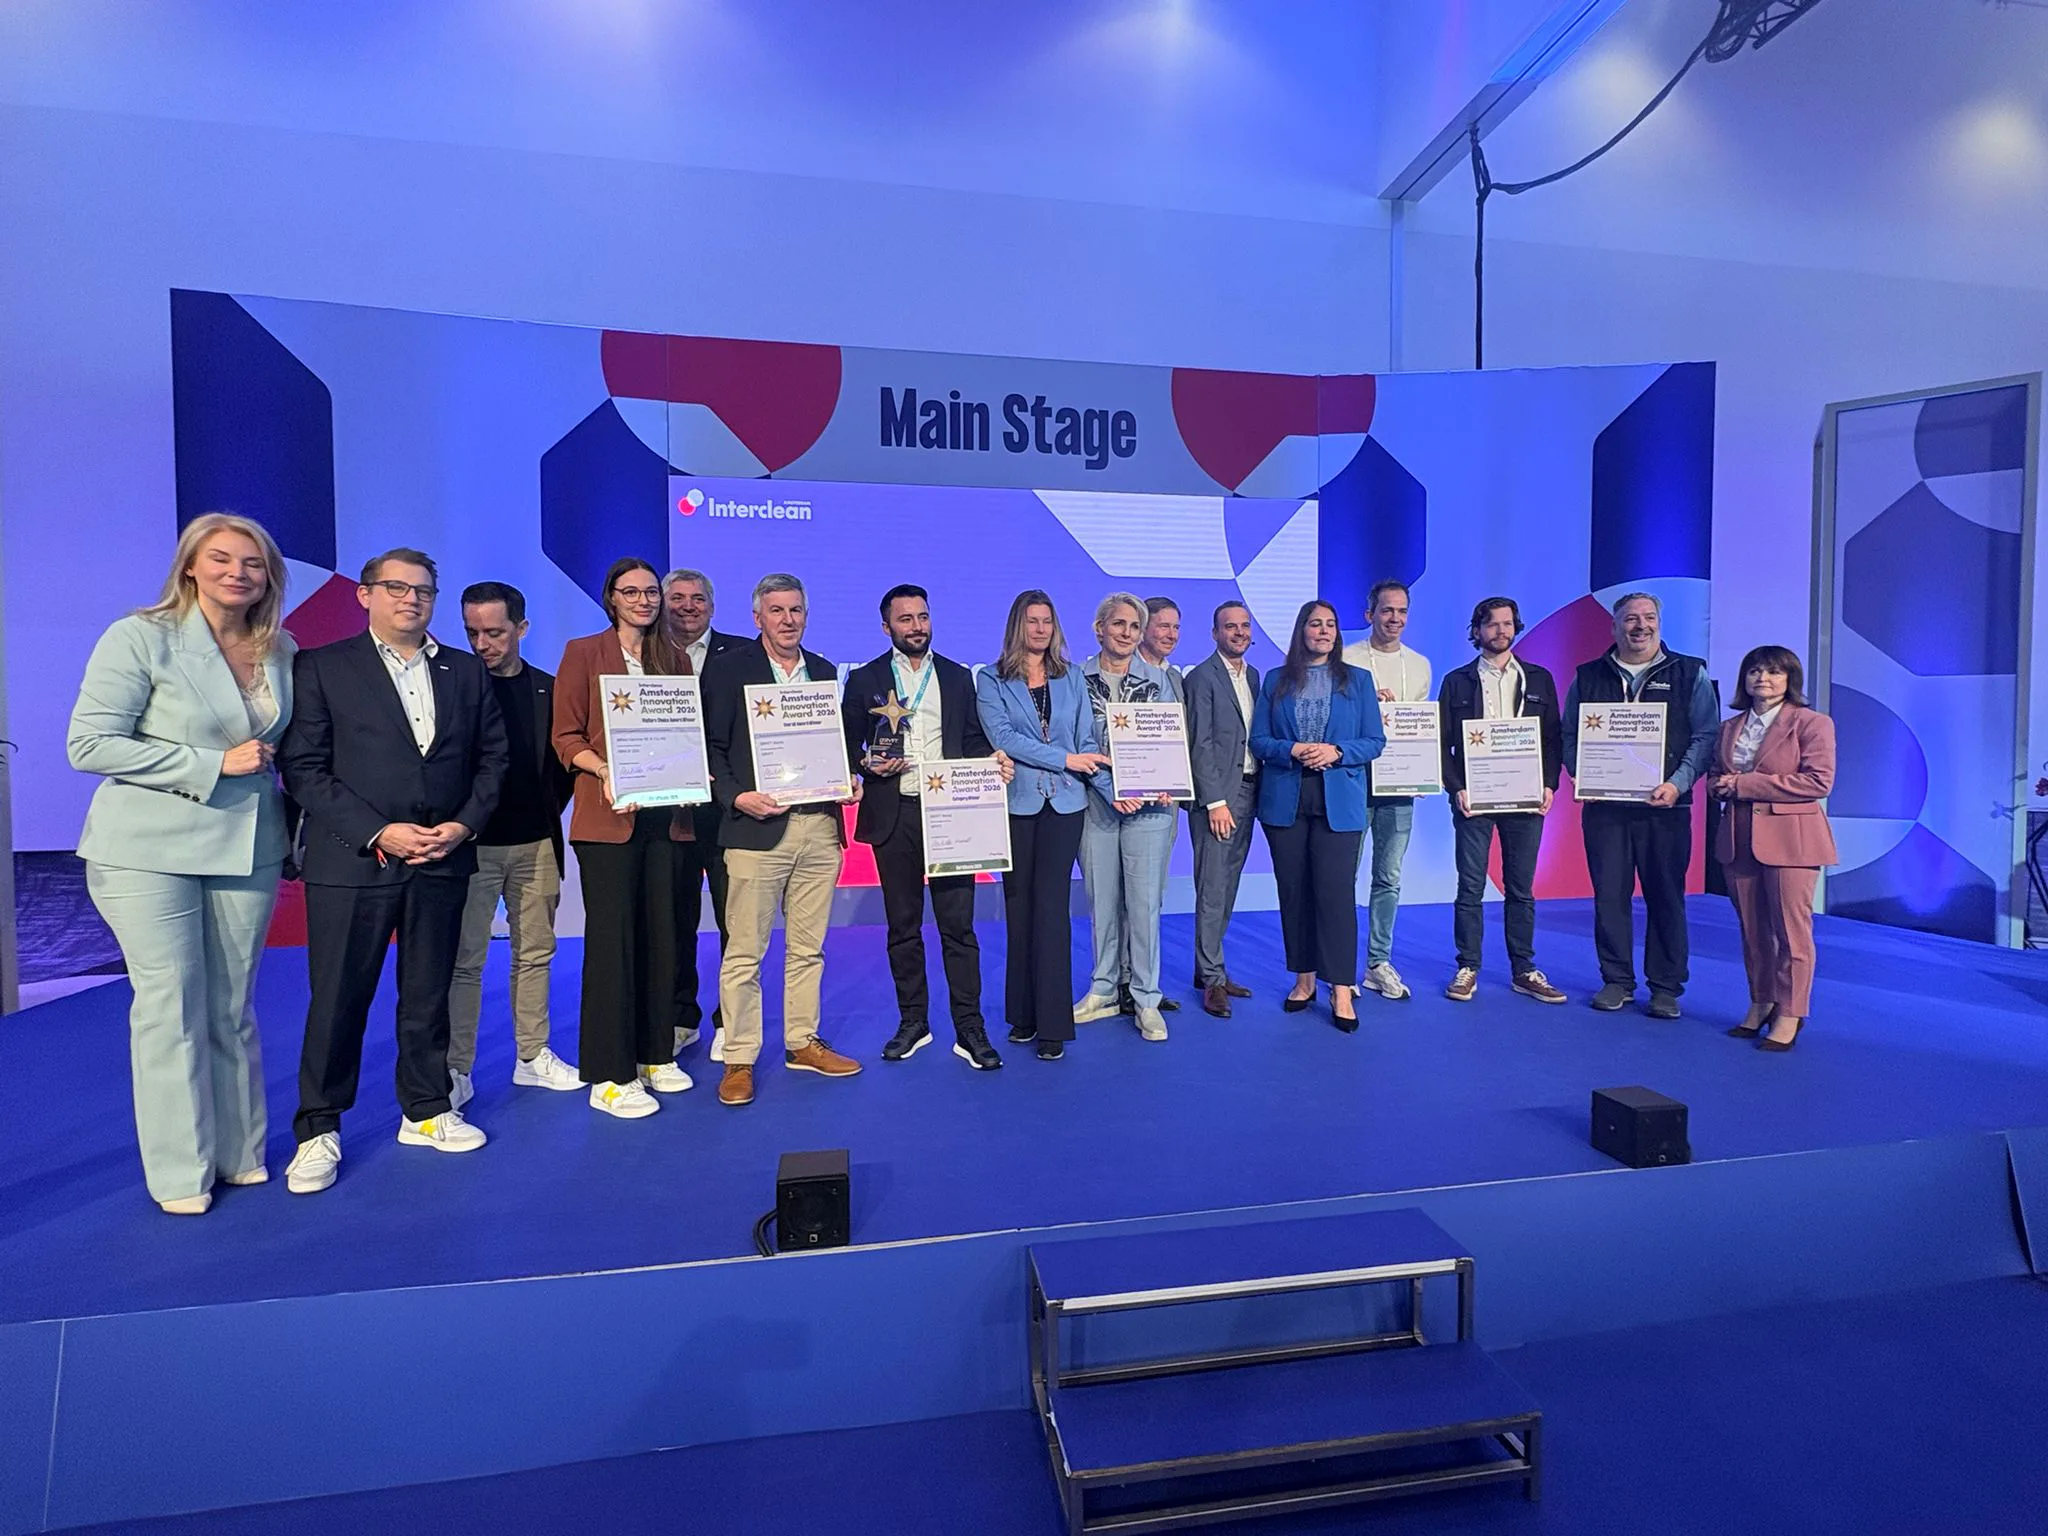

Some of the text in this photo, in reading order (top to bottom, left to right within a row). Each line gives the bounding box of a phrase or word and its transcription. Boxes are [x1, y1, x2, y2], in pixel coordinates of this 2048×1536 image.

[880, 386, 1137, 470] Main Stage
[708, 497, 812, 520] Interclean
[639, 688, 695, 696] Amsterdam
[640, 697, 690, 705] Innovation
[780, 692, 834, 702] Amsterdam
[641, 706, 696, 714] Award 2026
[781, 702, 830, 711] Innovation
[782, 709, 836, 719] Award 2026
[951, 768, 1001, 778] Amsterdam
[951, 777, 996, 786] Innovation
[952, 785, 980, 793] Award
